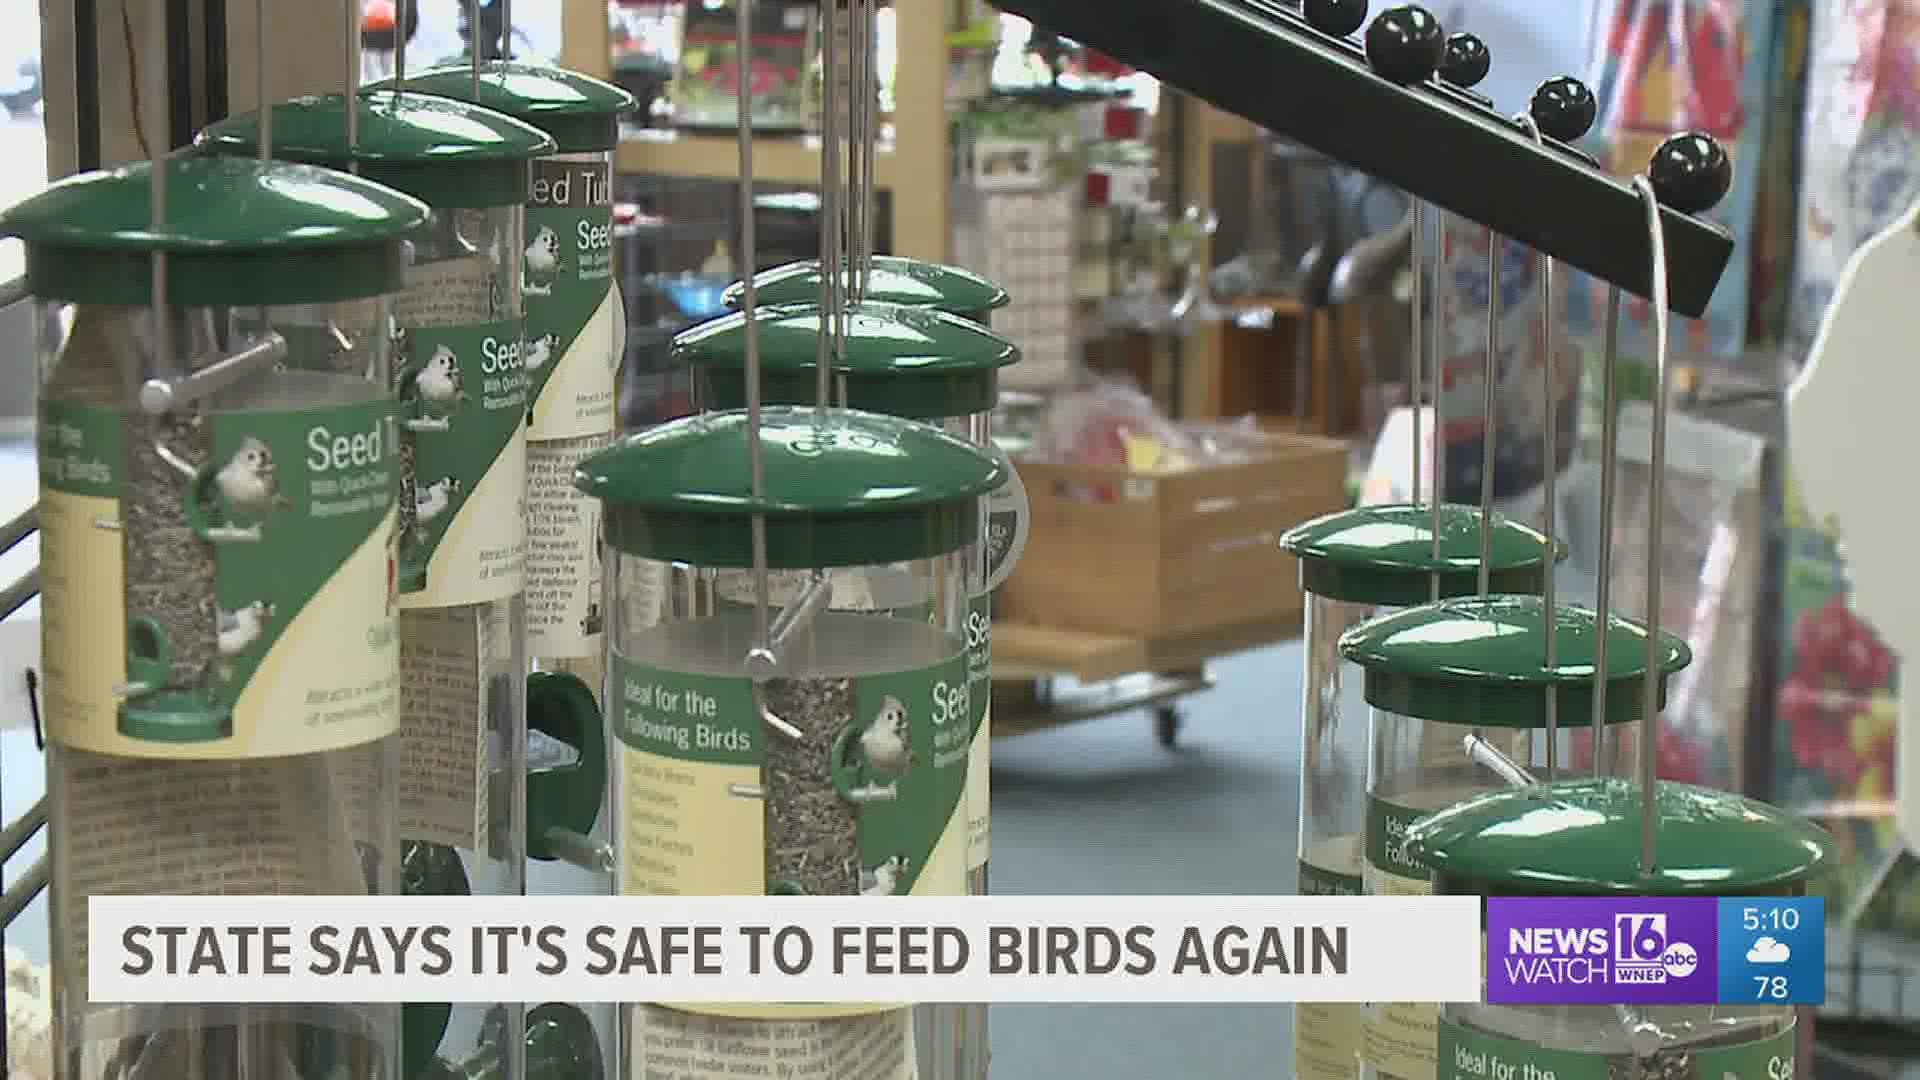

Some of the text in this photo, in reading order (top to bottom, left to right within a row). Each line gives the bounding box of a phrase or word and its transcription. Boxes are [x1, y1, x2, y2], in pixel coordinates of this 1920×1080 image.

[532, 172, 569, 205] ed
[307, 419, 381, 471] Seed
[656, 684, 680, 712] for
[685, 688, 717, 717] the
[696, 723, 751, 751] Birds
[1456, 1042, 1487, 1076] Ideal
[1491, 1055, 1517, 1080] for
